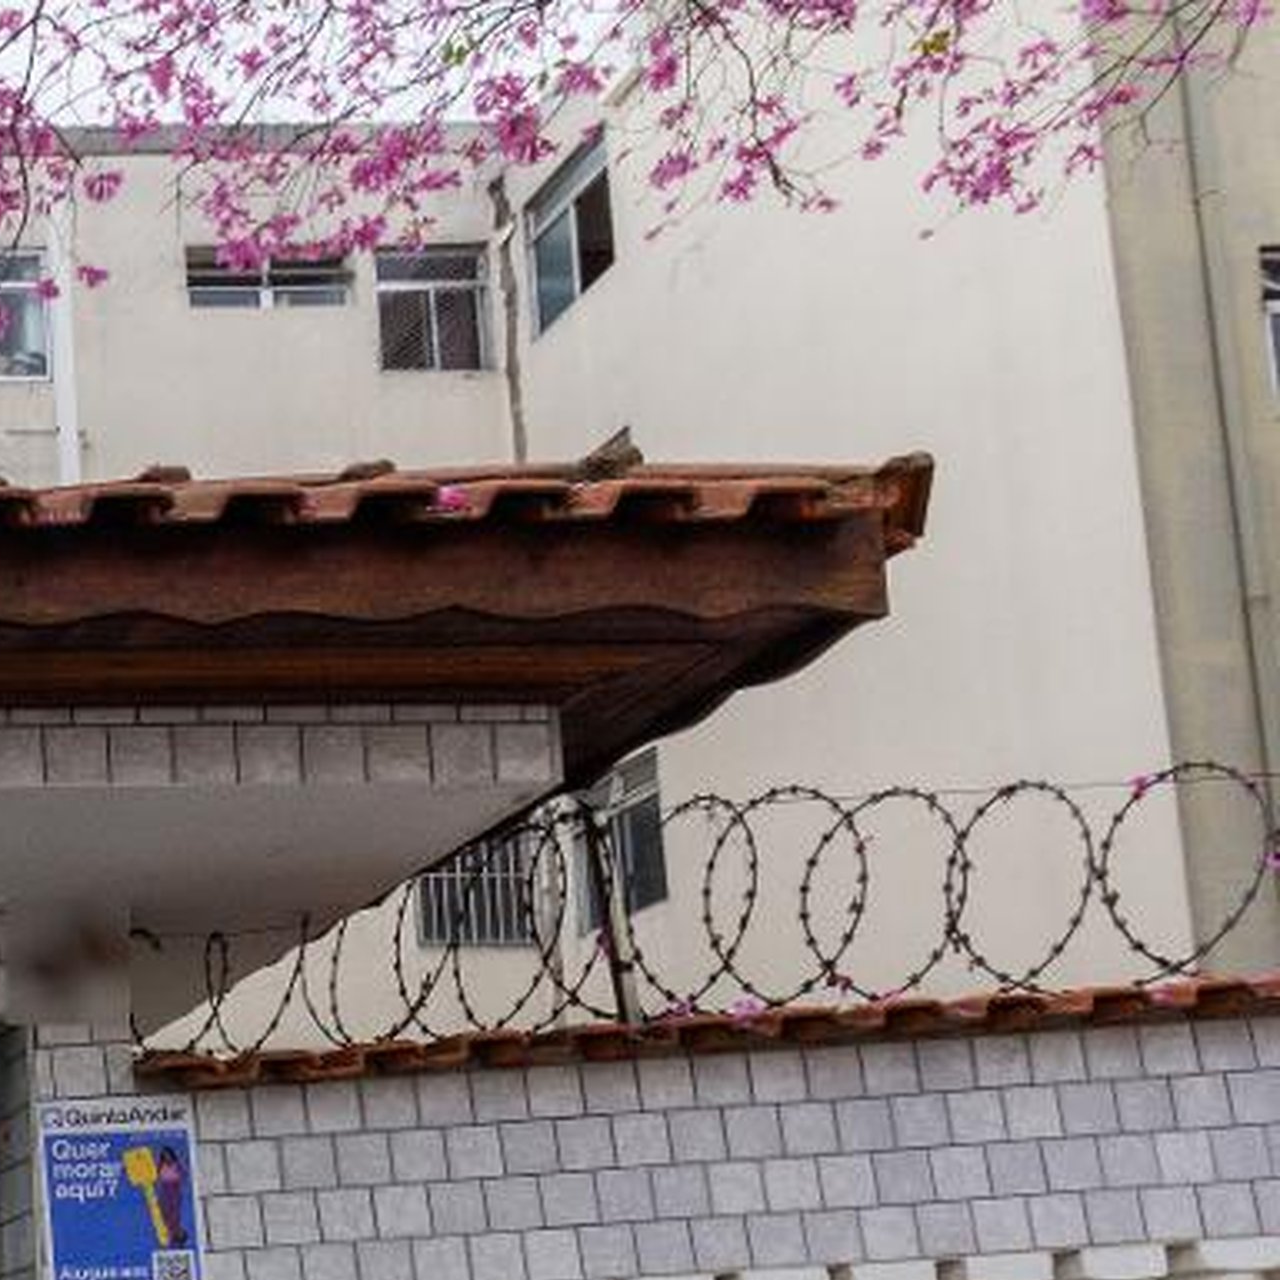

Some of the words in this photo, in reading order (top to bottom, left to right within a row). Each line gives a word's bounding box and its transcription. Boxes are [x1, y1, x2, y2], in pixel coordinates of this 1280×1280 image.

[66, 1106, 186, 1127] QuintaAndar
[52, 1139, 111, 1160] Quer
[53, 1162, 121, 1179] morar
[55, 1179, 119, 1204] aqui?
